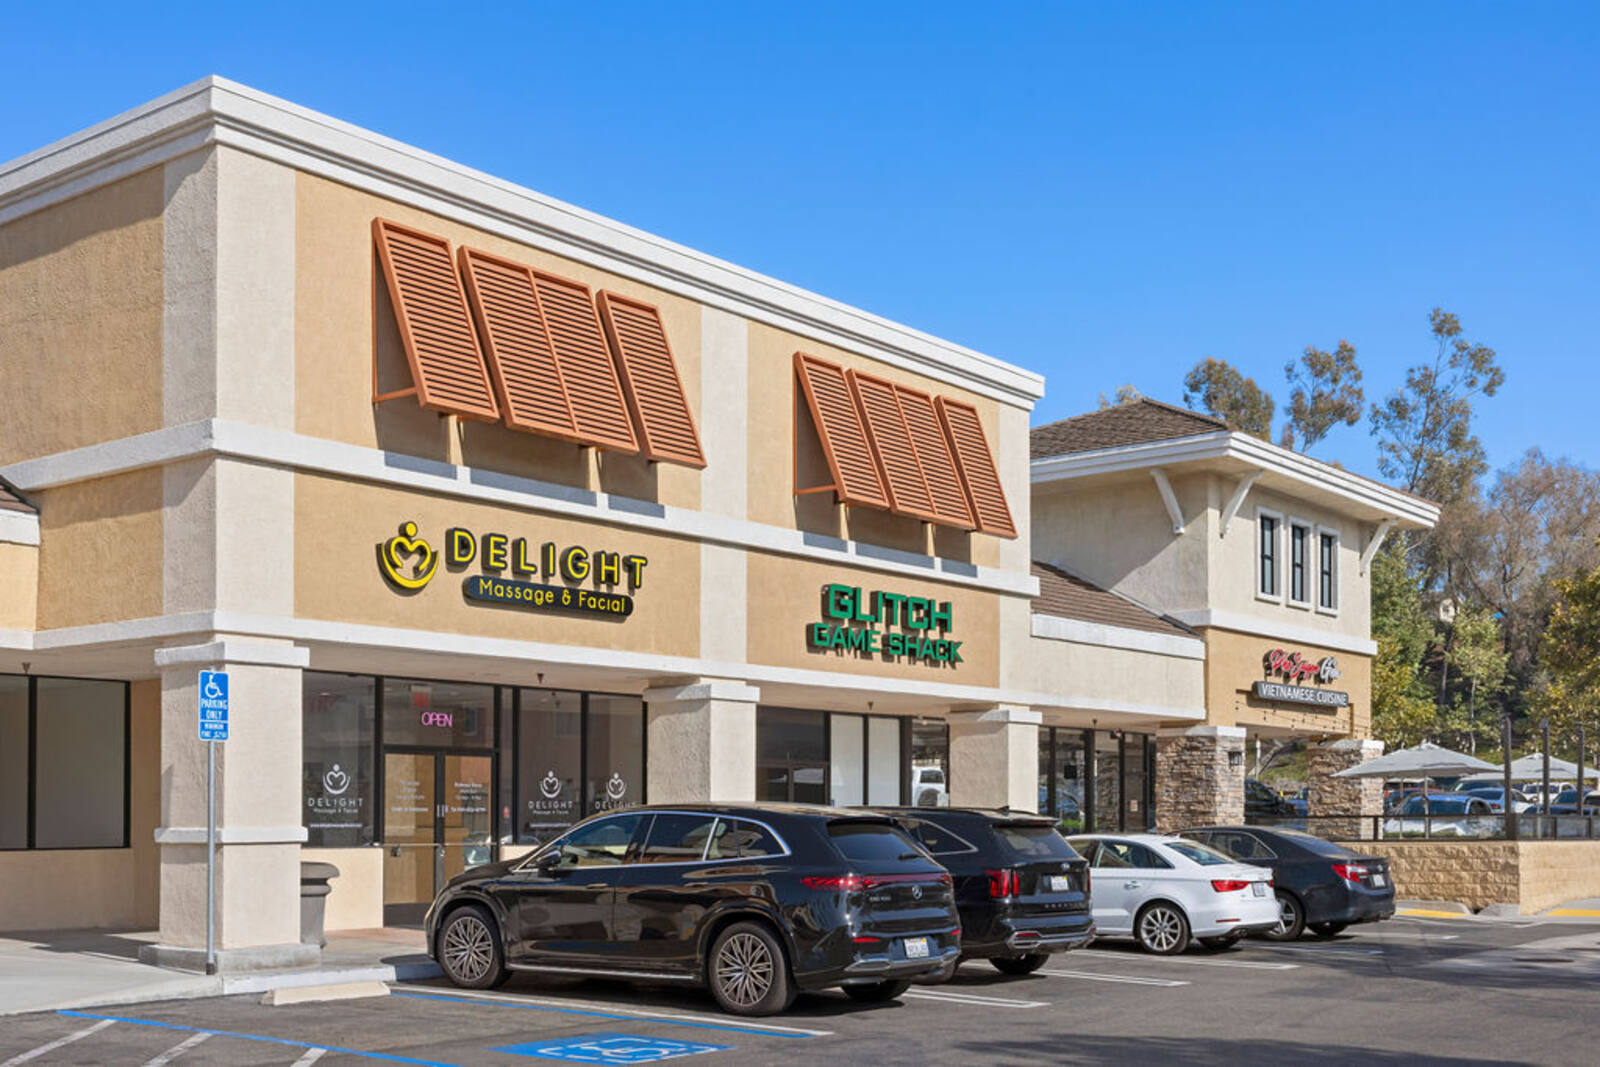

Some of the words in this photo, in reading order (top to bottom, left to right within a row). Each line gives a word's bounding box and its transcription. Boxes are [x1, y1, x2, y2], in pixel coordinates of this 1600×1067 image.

[449, 527, 648, 589] DELIGHT
[479, 578, 554, 605] Massage
[561, 589, 571, 605] &
[579, 591, 625, 613] Facial
[826, 583, 953, 633] GLITCH
[812, 623, 881, 653] GAME
[888, 633, 963, 663] SHACK
[201, 699, 228, 709] PARKING
[1261, 684, 1315, 701] VIETNAMESE
[1316, 691, 1347, 707] CUISINE
[206, 710, 223, 720] ONLY
[421, 712, 453, 727] OPEN
[308, 798, 363, 807] DELIGHT
[528, 800, 573, 809] DELIGHT
